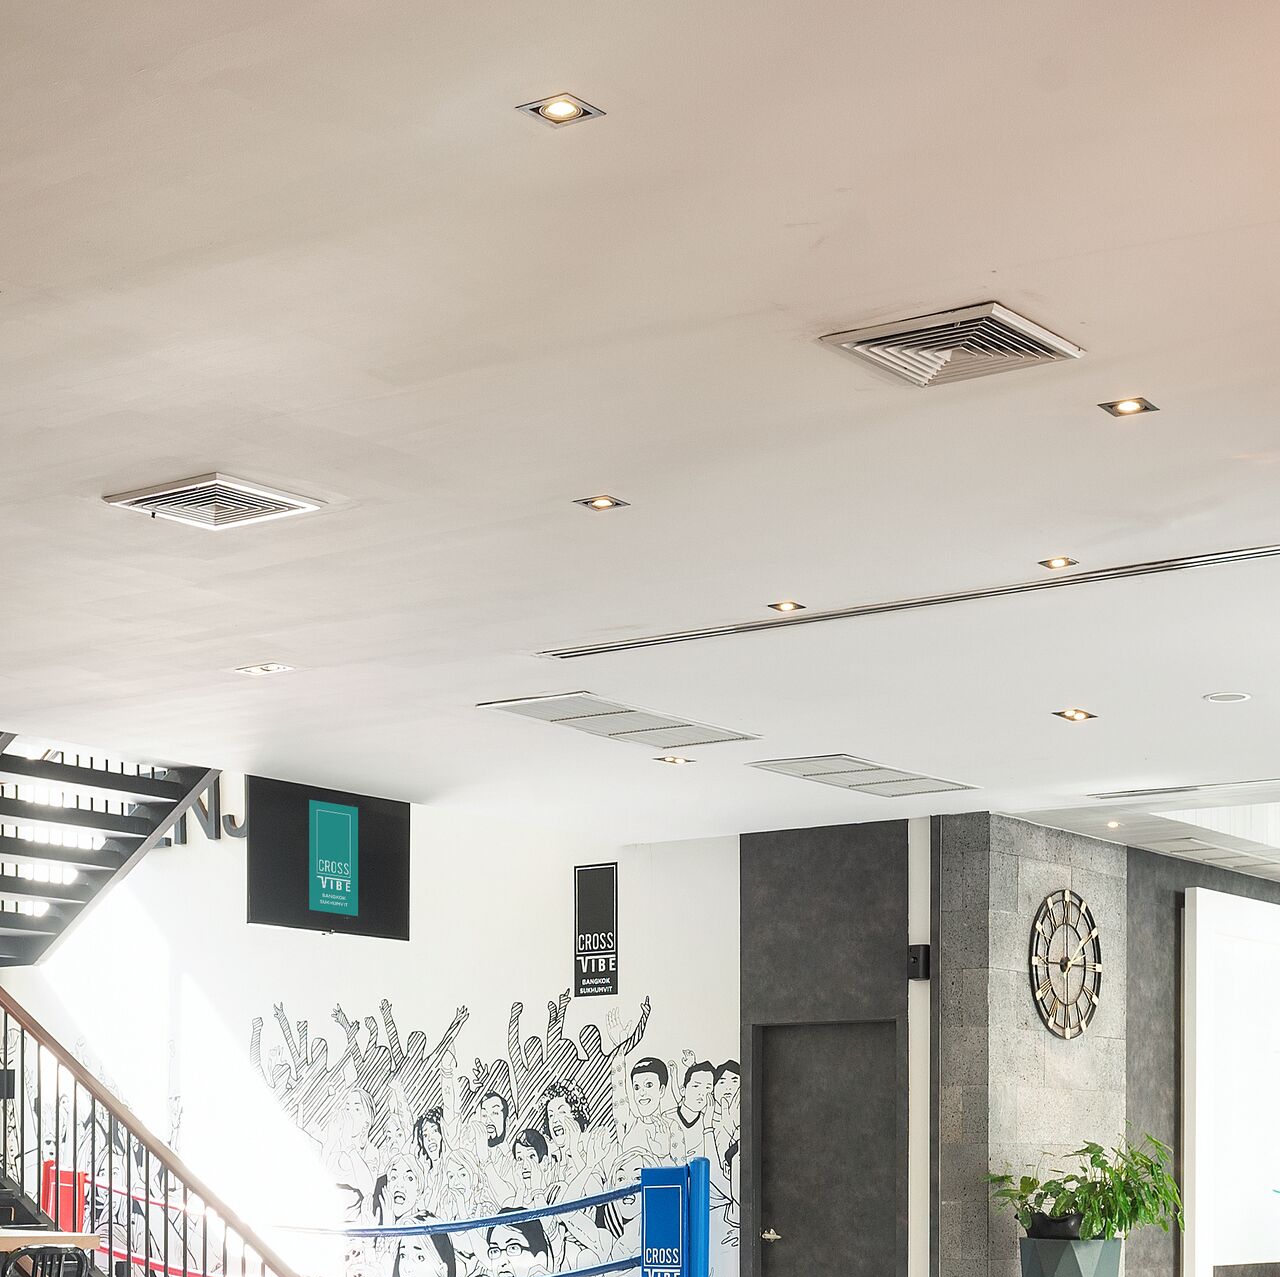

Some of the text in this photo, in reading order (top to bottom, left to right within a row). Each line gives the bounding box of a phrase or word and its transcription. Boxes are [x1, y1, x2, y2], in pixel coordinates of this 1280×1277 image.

[318, 859, 350, 875] CROSS
[316, 875, 351, 892] VIBE
[578, 932, 614, 951] CROSS
[576, 954, 616, 973] VIBE
[581, 977, 611, 985] BANGKOK
[579, 986, 613, 994] SUKHUMVIT
[645, 1247, 679, 1264] CROSS
